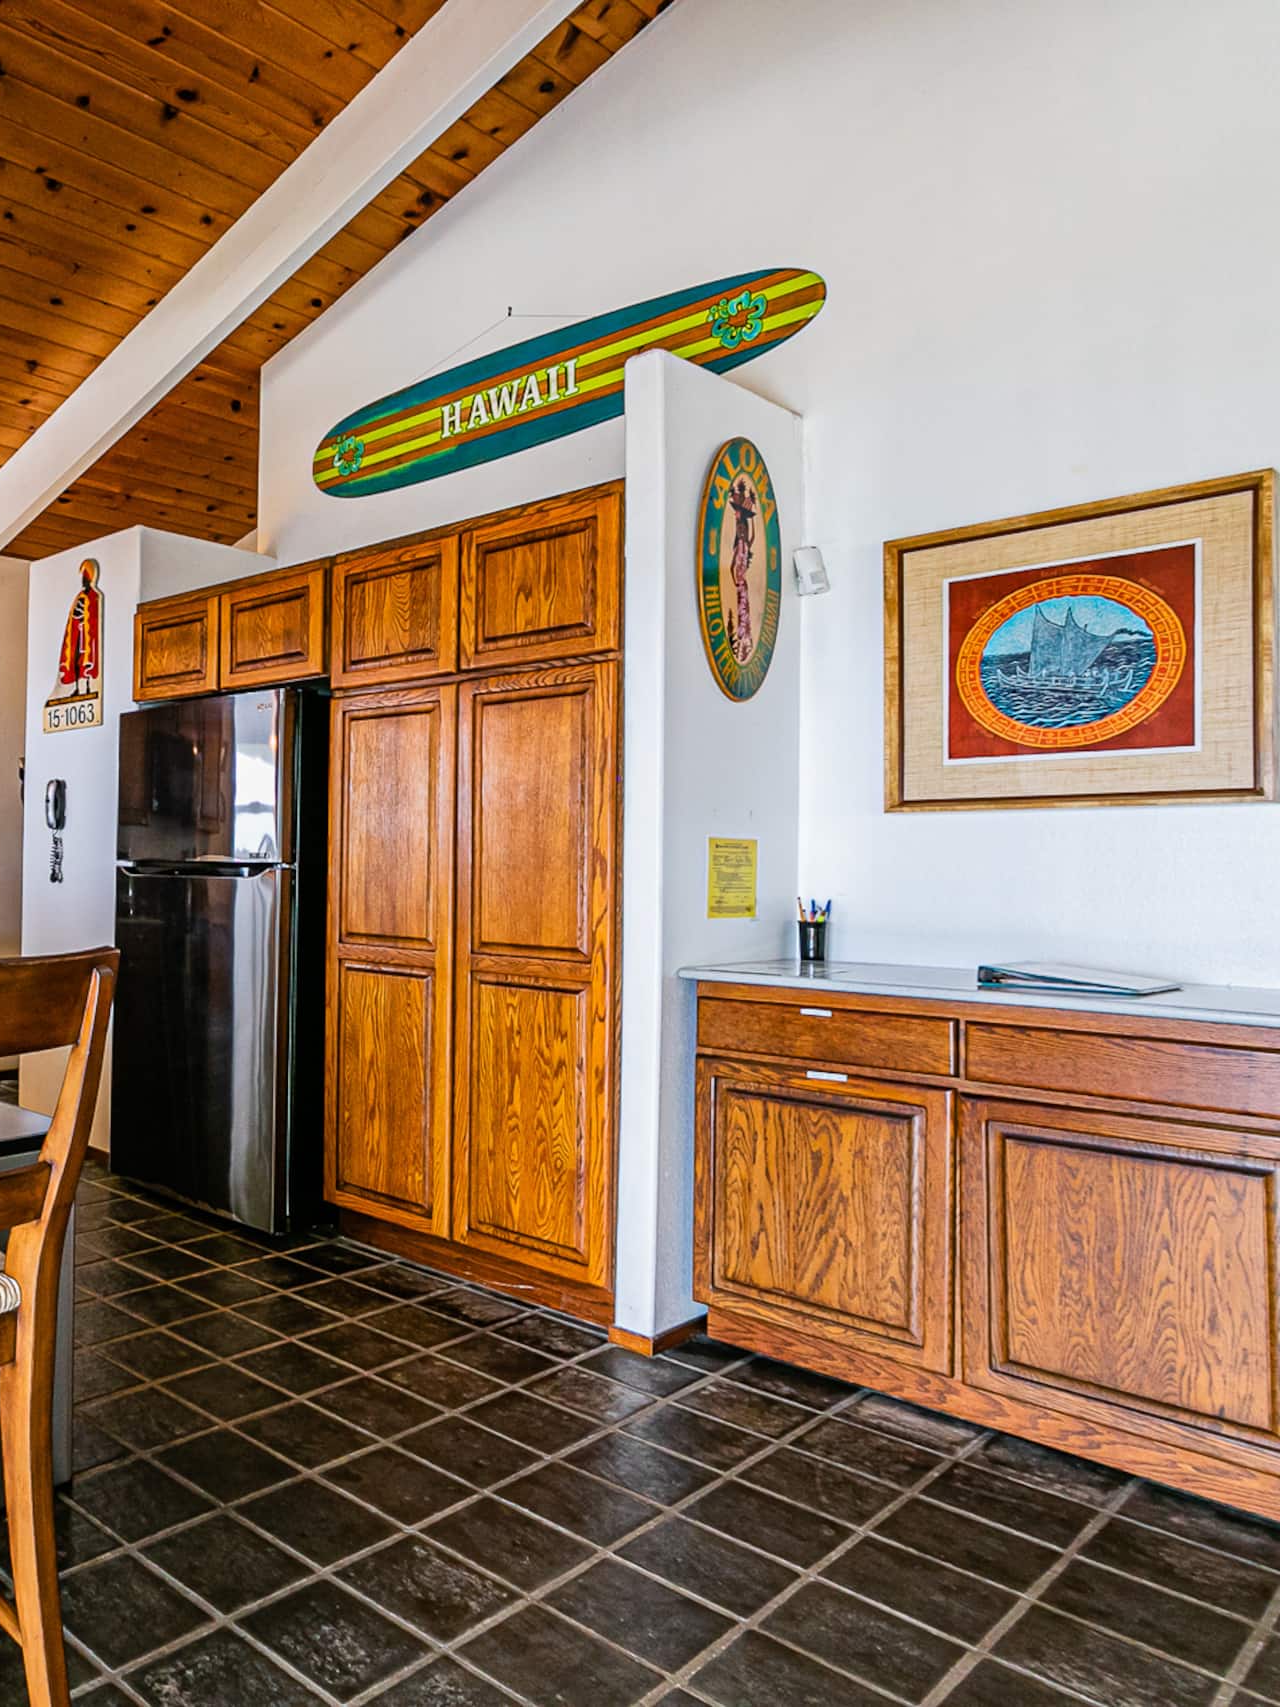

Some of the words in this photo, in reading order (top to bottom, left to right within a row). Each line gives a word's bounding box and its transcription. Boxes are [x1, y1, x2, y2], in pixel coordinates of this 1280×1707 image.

[441, 359, 578, 438] HAWAII
[713, 444, 775, 524] ALOHA
[48, 703, 95, 728] 15-1063
